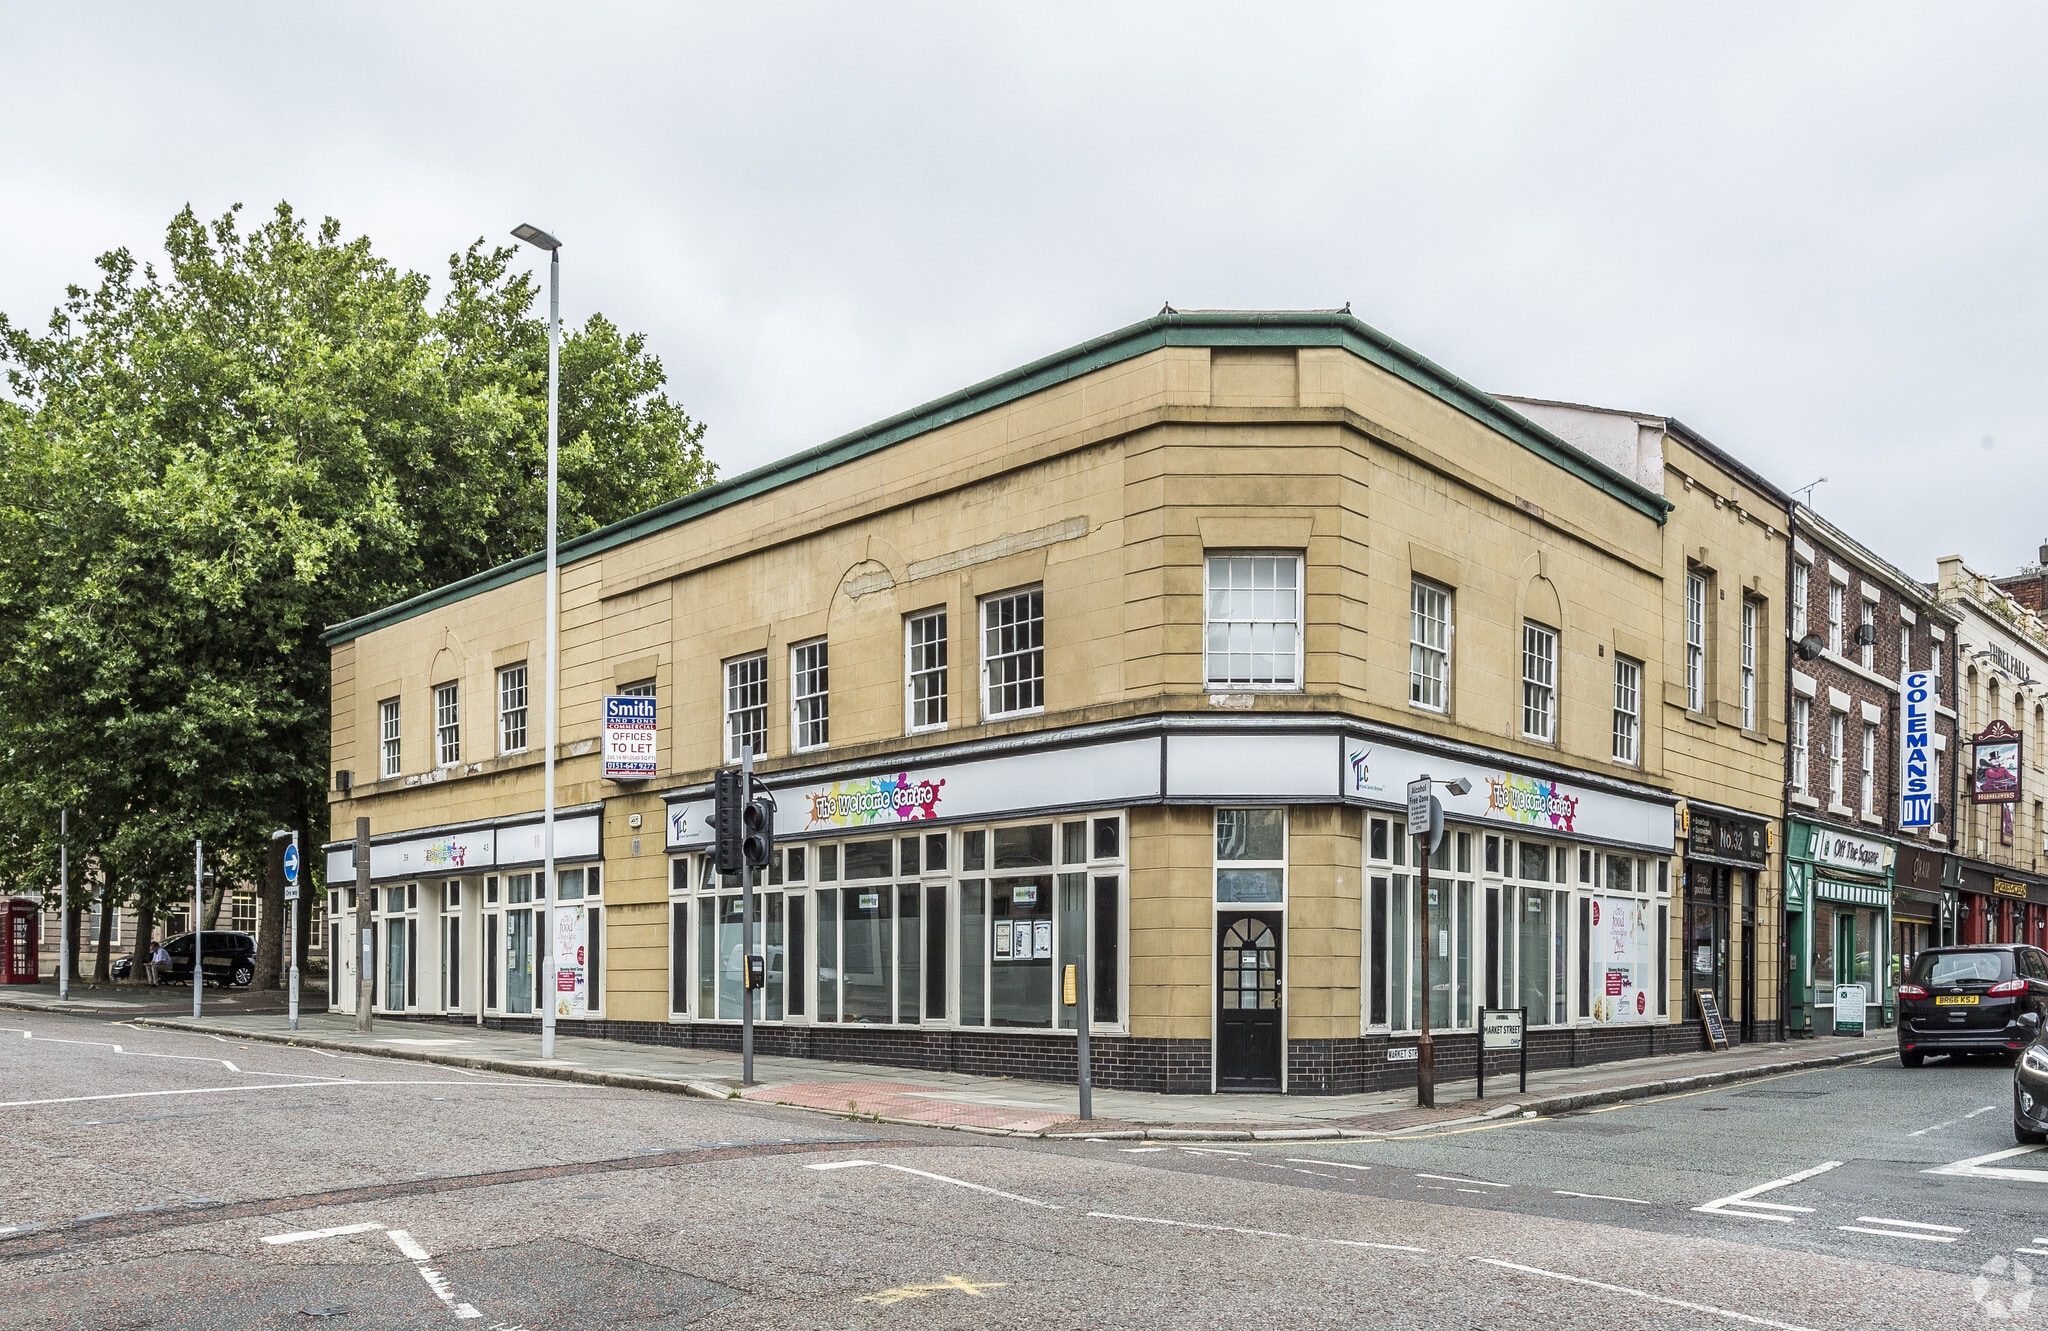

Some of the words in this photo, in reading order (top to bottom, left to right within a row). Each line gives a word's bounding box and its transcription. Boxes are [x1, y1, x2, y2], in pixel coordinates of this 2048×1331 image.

[1988, 641, 2030, 681] THRELFALLS
[609, 700, 654, 716] Smith
[612, 732, 652, 740] OFFICES
[1906, 674, 1928, 793] COLEMANS
[611, 743, 627, 753] TO
[630, 744, 652, 753] LET
[1350, 748, 1372, 790] TLC
[1412, 784, 1426, 794] Alcohol
[1419, 795, 1428, 803] Zone
[1494, 784, 1509, 808] The
[1510, 786, 1546, 812] Welcome
[1547, 795, 1572, 817] Centre
[816, 796, 836, 818] The
[838, 792, 890, 816] Welcome
[892, 786, 933, 809] Centre
[1904, 798, 1931, 822] DIY
[672, 806, 689, 840] TLC
[1720, 827, 1743, 851] No.32
[1834, 839, 1846, 857] Off
[1847, 842, 1858, 861] The
[1859, 844, 1879, 866] Square
[1694, 886, 1703, 895] good
[1483, 1026, 1502, 1034] MARKET
[1503, 1025, 1520, 1034] STREET
[1389, 1050, 1407, 1059] MARKET
[1408, 1048, 1418, 1058] STR
